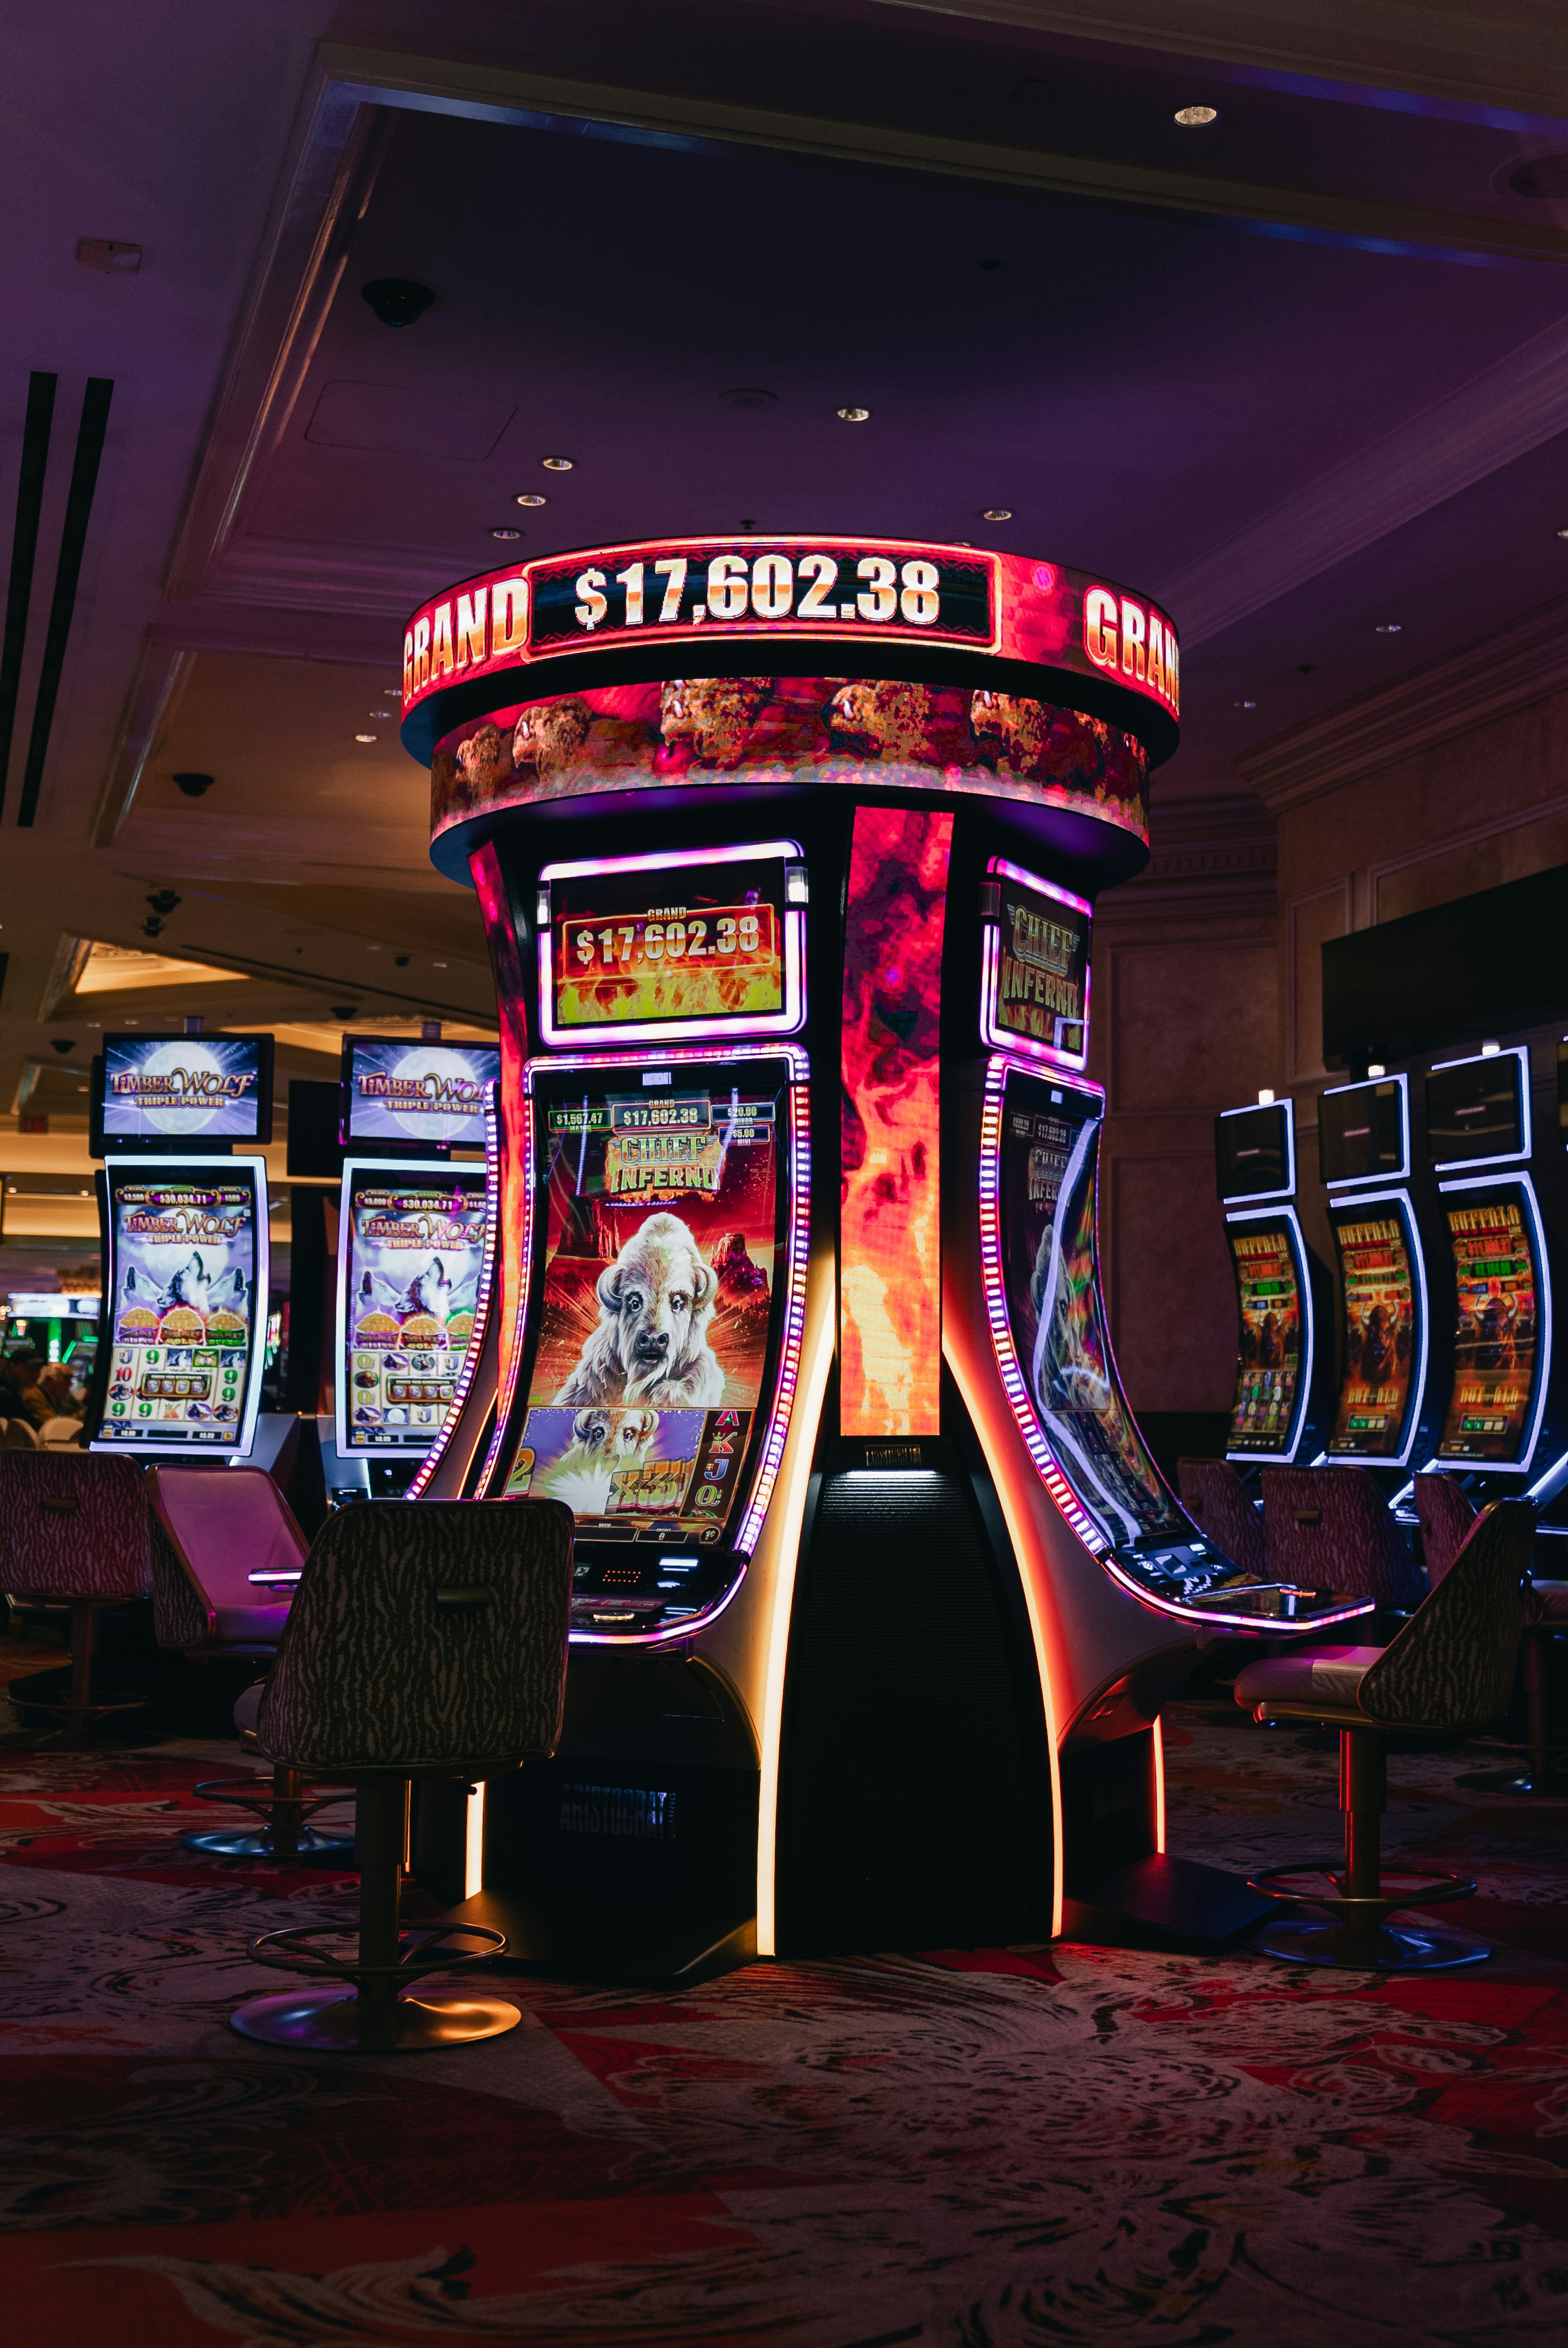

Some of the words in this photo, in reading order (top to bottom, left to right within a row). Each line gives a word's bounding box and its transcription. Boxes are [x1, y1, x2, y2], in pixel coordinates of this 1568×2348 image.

[575, 555, 940, 630] $17,602.38
[404, 578, 529, 707] GRAND
[1087, 589, 1179, 716] GRAN
[648, 907, 687, 921] GRAND
[577, 916, 759, 965] $17,602.38
[1013, 907, 1074, 976] CHIEF
[1003, 957, 1078, 1019] INFERNO
[172, 1068, 257, 1098] WOLF
[137, 1097, 178, 1106] TRIPLE
[181, 1097, 224, 1107] POWER
[386, 1101, 430, 1111] TRIPLE
[433, 1102, 479, 1114] POWER
[648, 1099, 675, 1109] GRAND
[556, 1113, 603, 1126] $1,567.47
[623, 1108, 698, 1126] $17,602.38
[620, 1136, 708, 1167] CHIEF
[610, 1166, 721, 1193] INFERNO
[176, 1211, 246, 1237] WOLF
[185, 1235, 221, 1243] POWER
[146, 1350, 160, 1365] 9
[115, 1367, 133, 1381] 10
[224, 1369, 238, 1384] 9
[221, 1387, 236, 1402] 9
[112, 1402, 125, 1417] 9
[138, 1403, 152, 1418] 9
[163, 1403, 179, 1419] K
[715, 1410, 739, 1426] A
[709, 1432, 737, 1453] K
[704, 1459, 730, 1481] J
[695, 1485, 720, 1507] Q
[659, 1532, 665, 1540] 0
[560, 1784, 667, 1839] ARISTOCRAT
